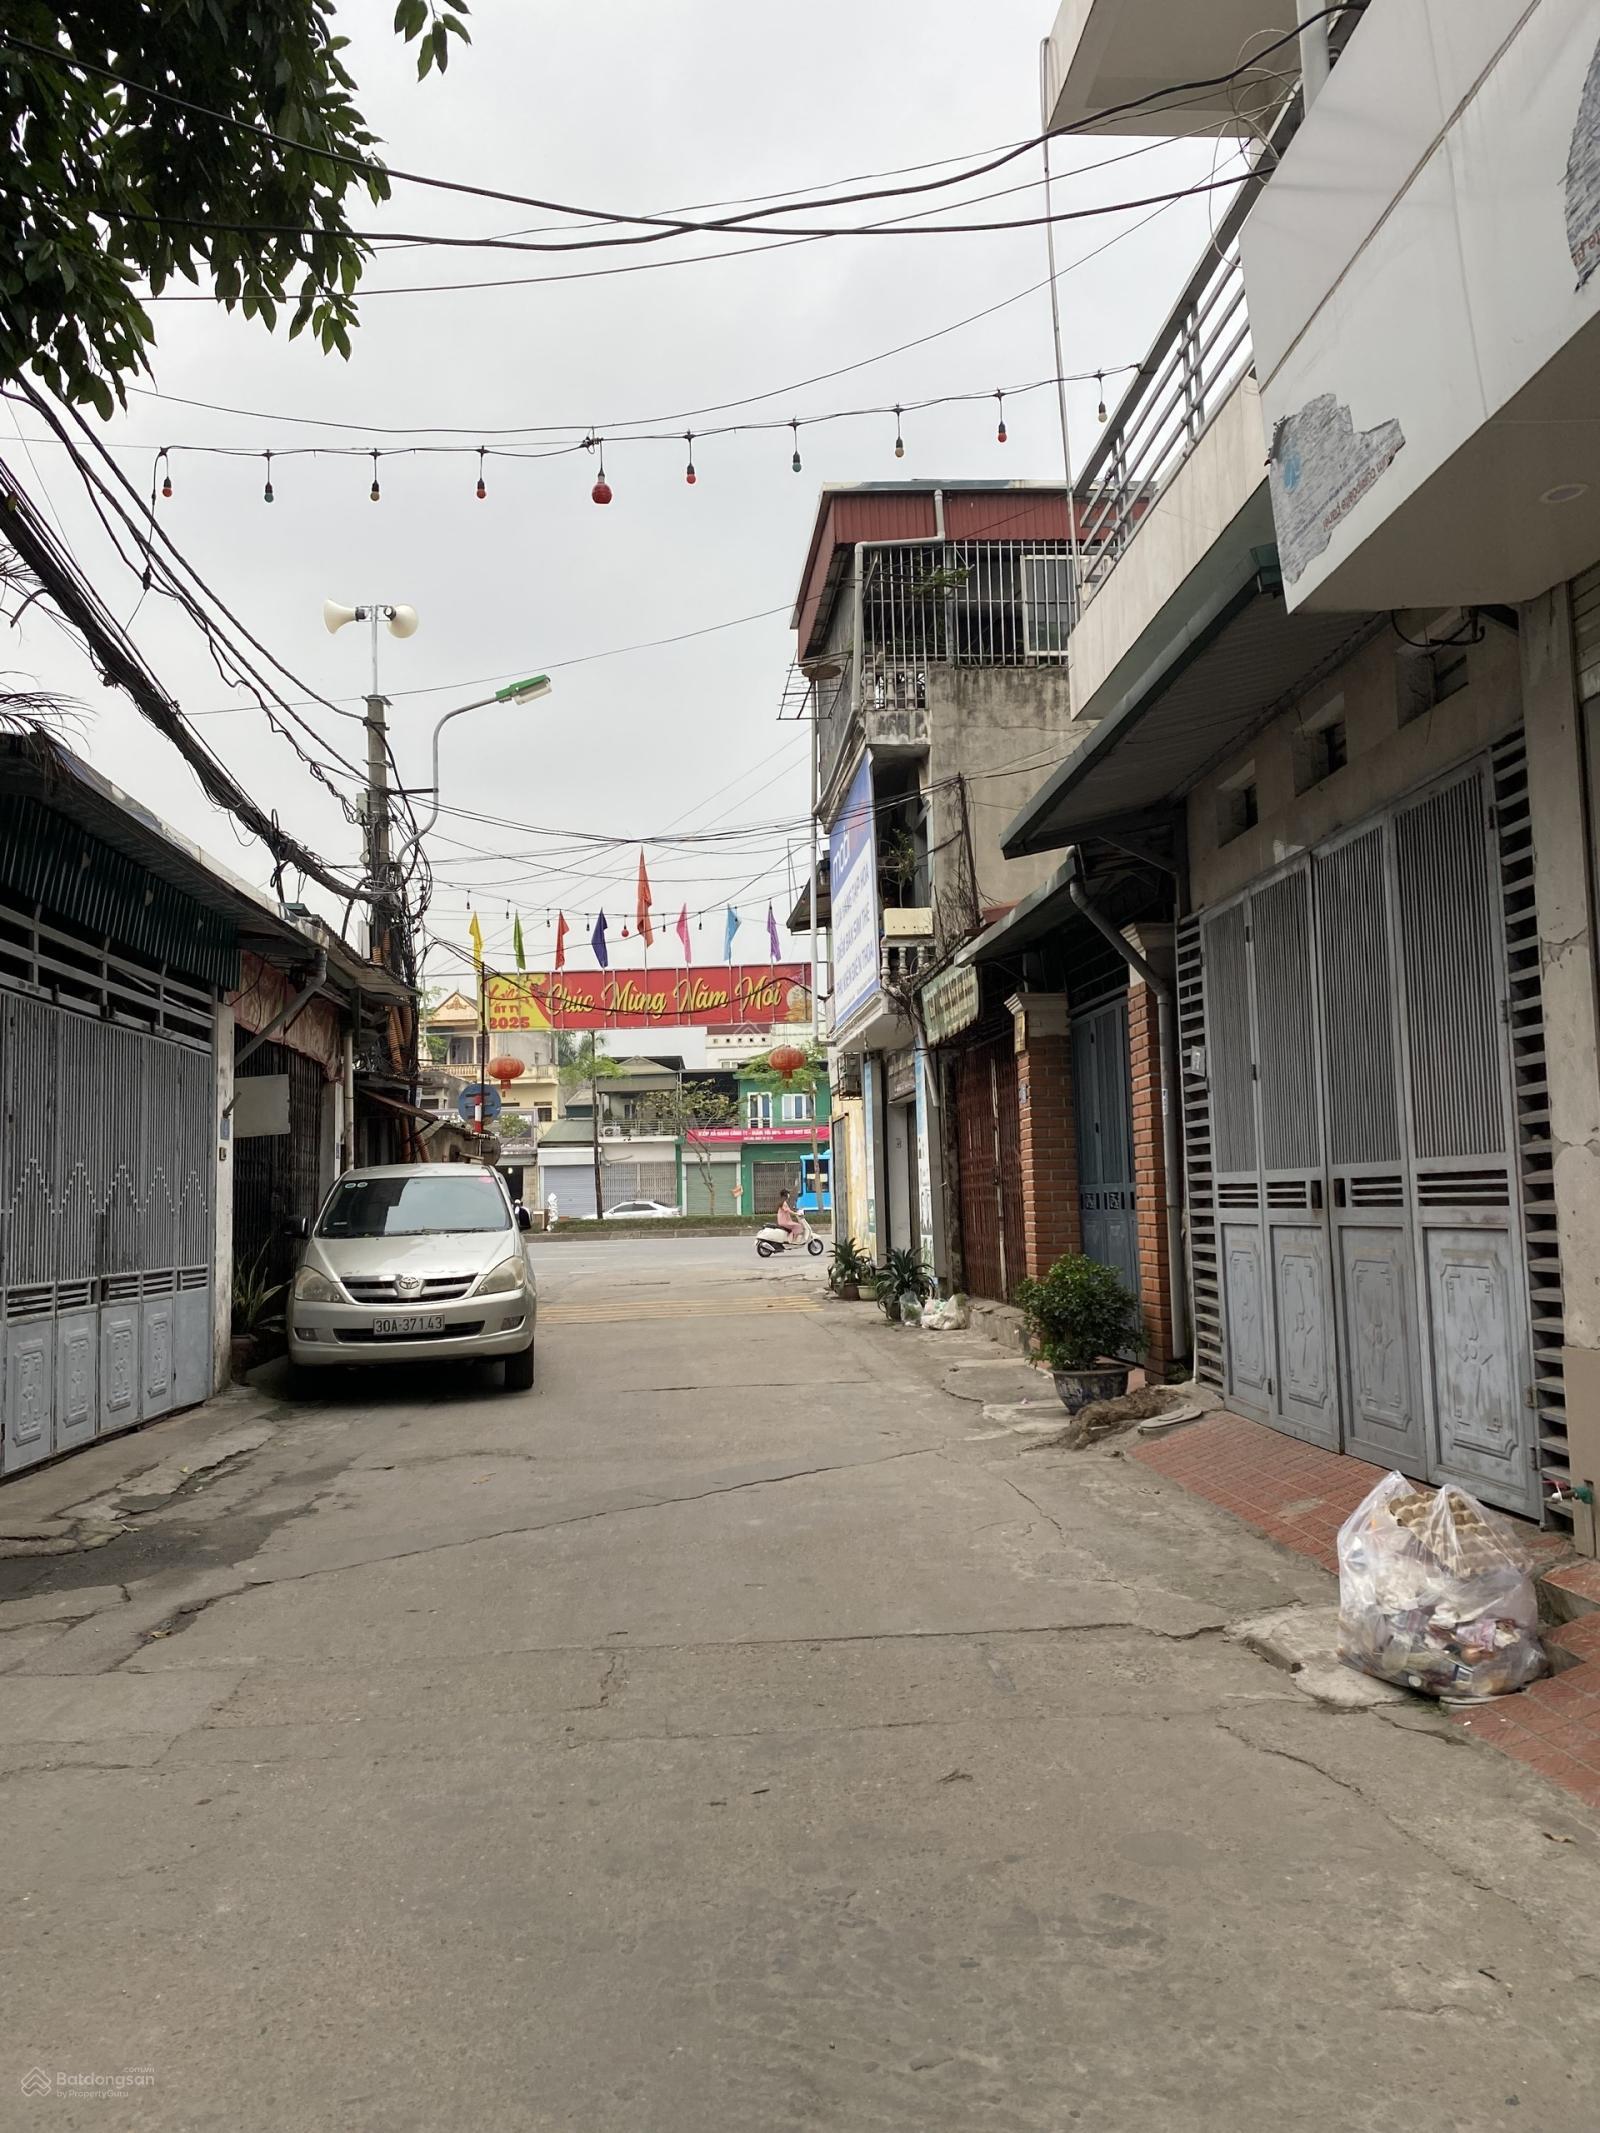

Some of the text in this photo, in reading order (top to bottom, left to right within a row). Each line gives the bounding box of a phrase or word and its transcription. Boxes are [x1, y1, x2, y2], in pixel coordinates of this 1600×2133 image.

[545, 983, 595, 1017] Chúc
[603, 980, 667, 1016] Mừng
[673, 978, 729, 1016] Năm
[489, 1016, 530, 1029] 2025
[376, 1317, 442, 1333] 30A-371.43
